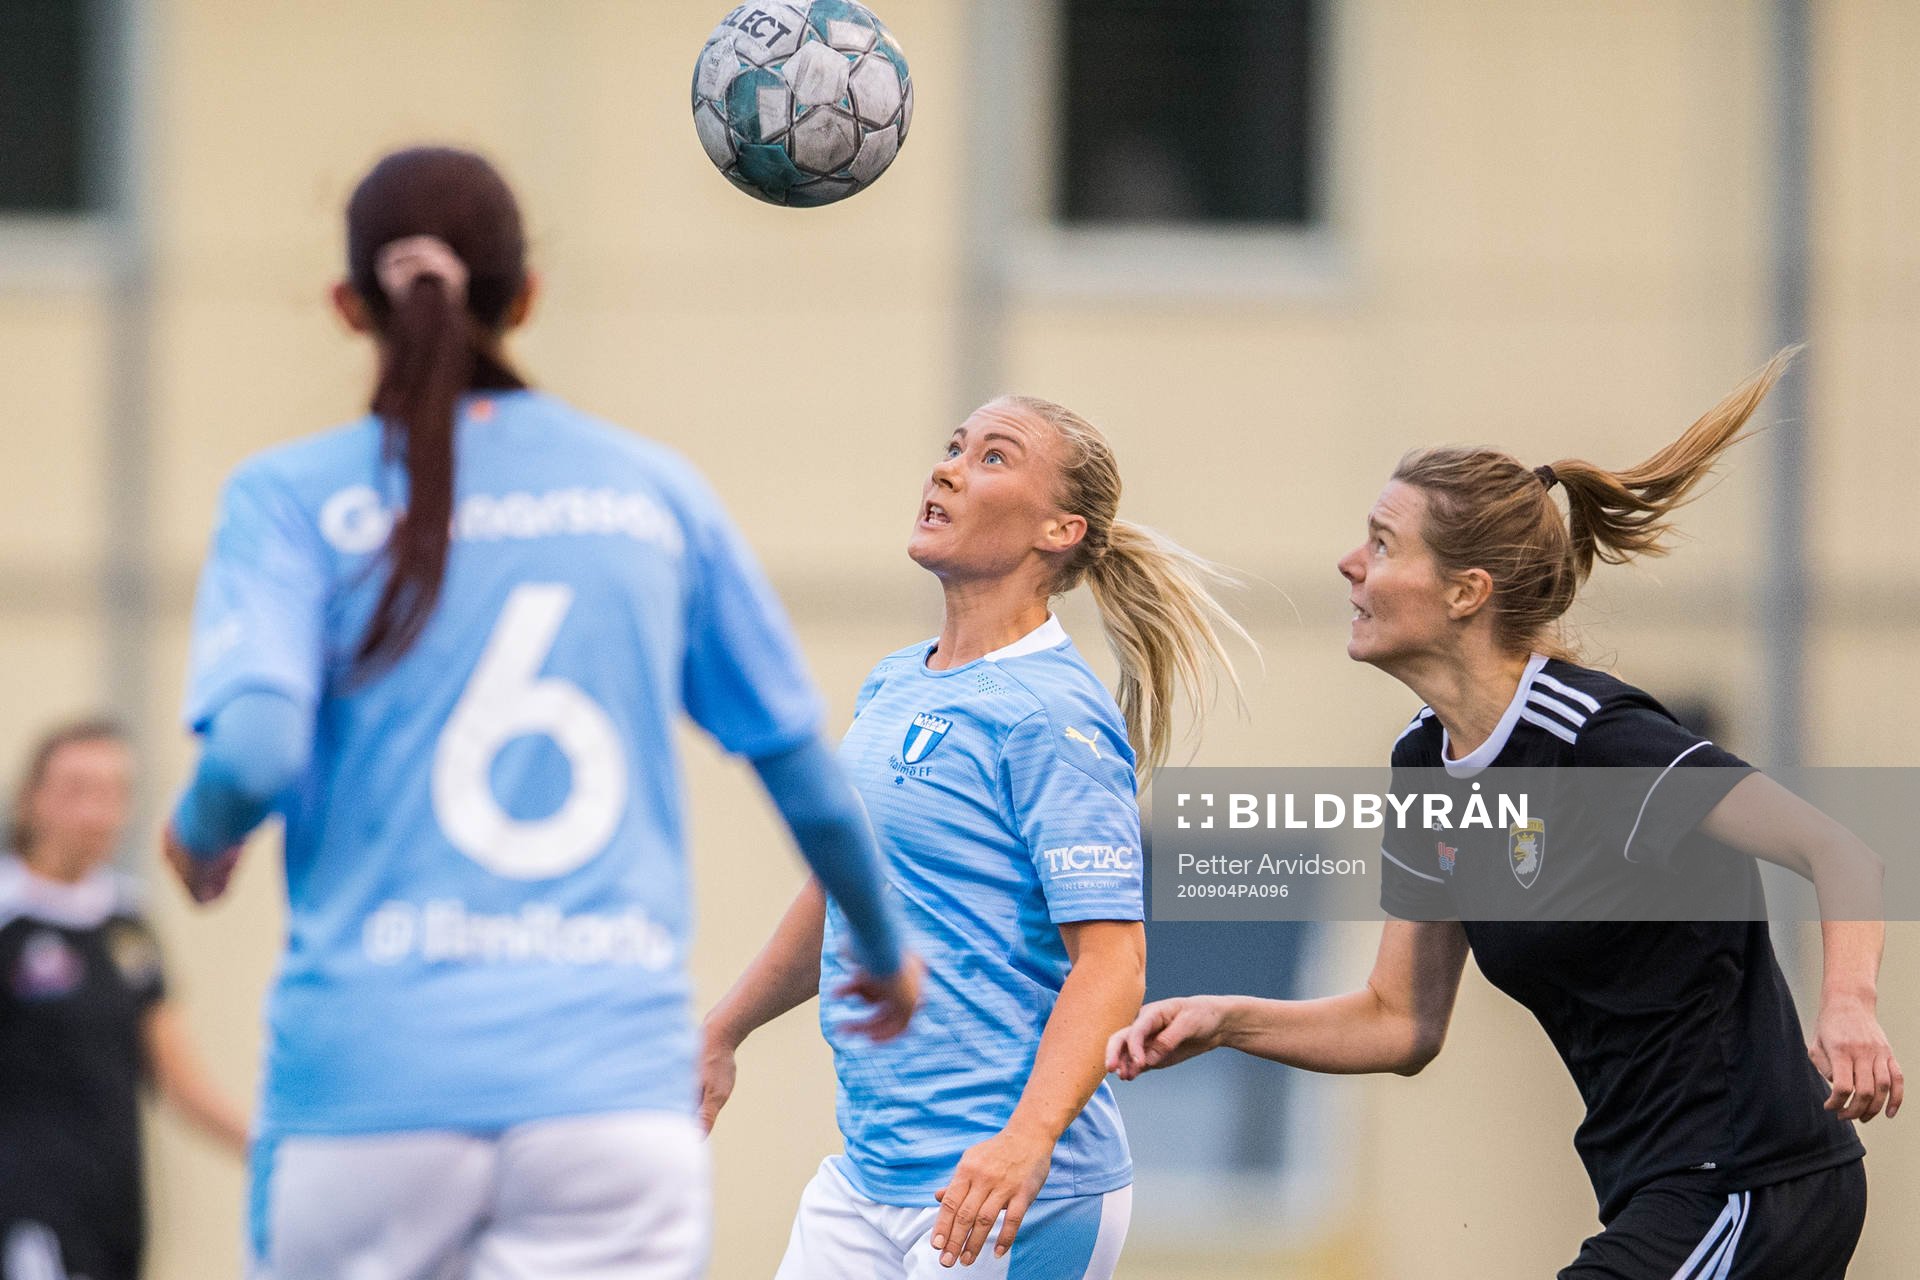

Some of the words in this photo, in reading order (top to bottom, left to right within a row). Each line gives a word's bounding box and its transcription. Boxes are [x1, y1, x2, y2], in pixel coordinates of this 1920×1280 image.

[320, 485, 685, 556] Gnarsson
[431, 582, 627, 881] 6
[919, 766, 934, 777] FF
[1044, 845, 1133, 873] TICTAC
